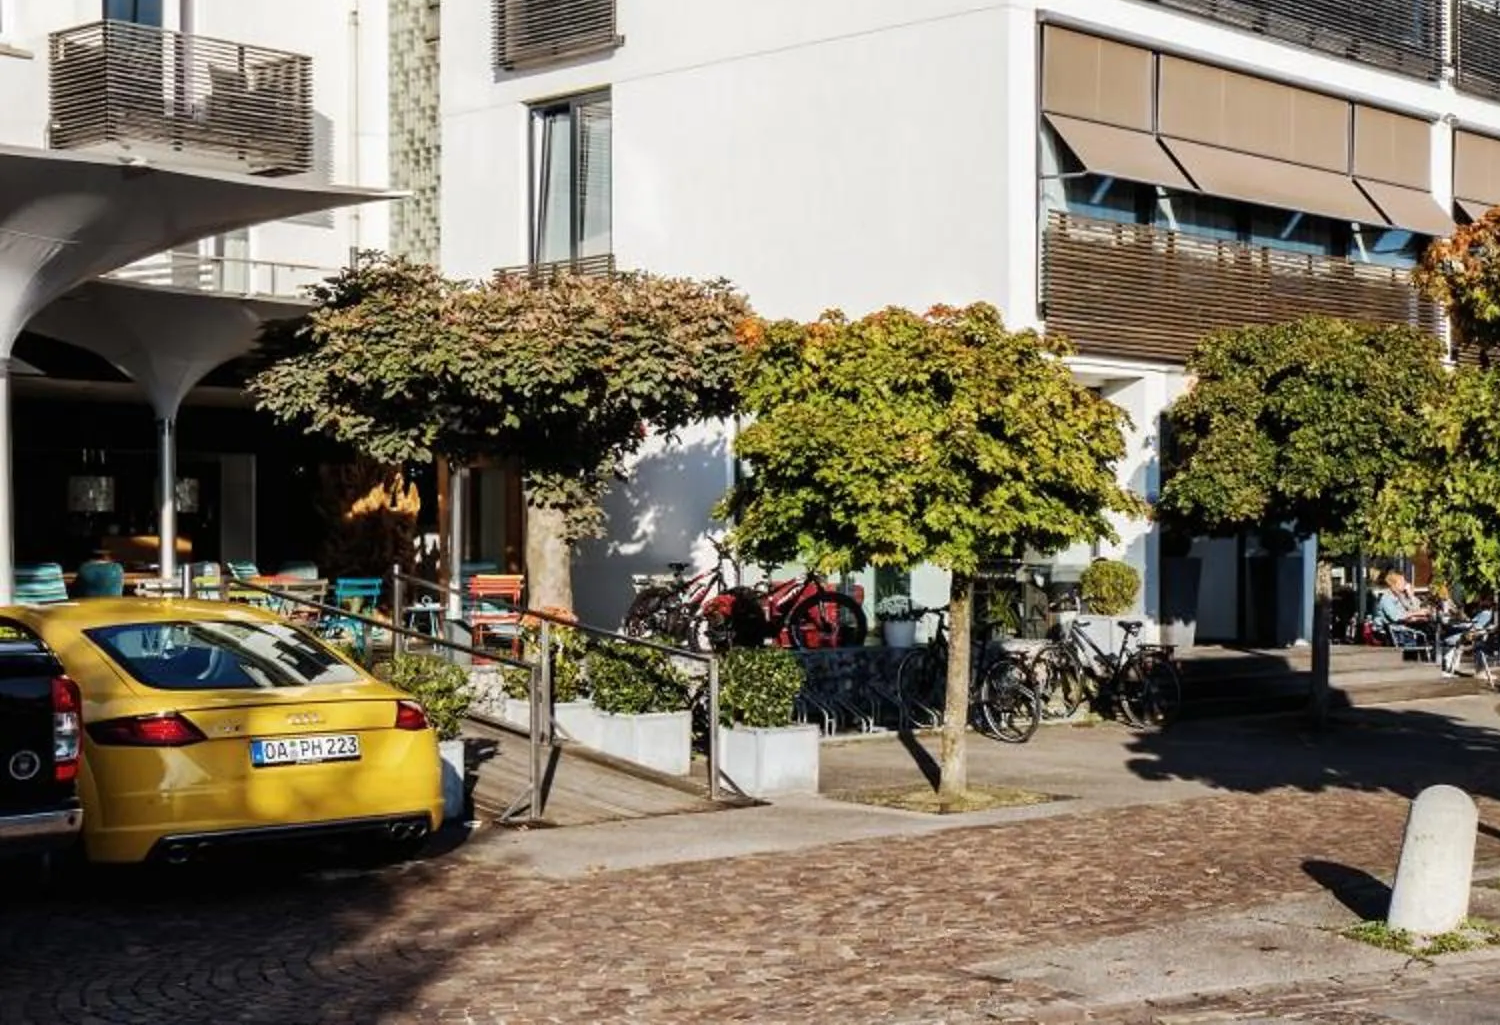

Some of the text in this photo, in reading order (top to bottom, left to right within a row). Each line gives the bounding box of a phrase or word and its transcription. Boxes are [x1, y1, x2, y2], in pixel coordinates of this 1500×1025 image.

[265, 736, 357, 759] OA PH 223
